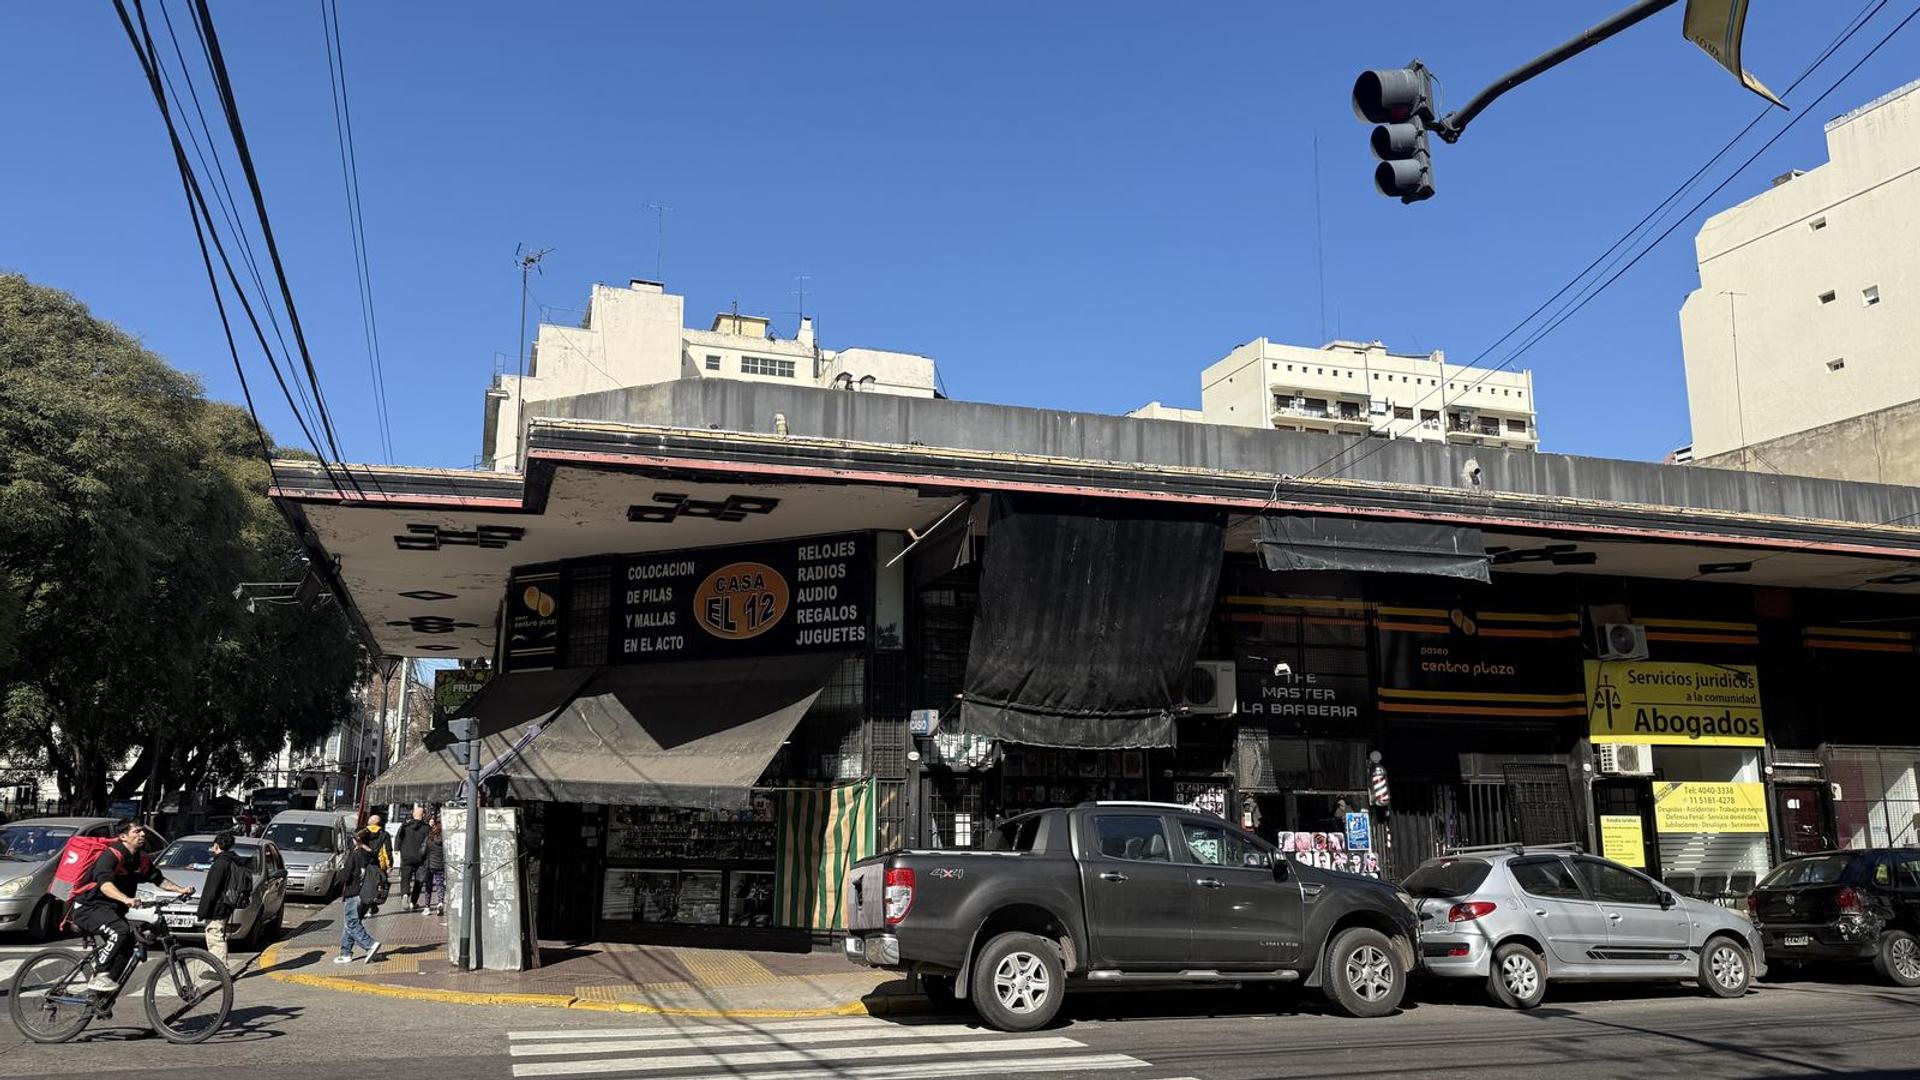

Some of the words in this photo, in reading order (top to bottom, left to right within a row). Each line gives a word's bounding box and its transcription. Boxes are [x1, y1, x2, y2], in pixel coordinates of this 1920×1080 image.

[798, 541, 855, 561] RELOJES
[628, 562, 695, 580] COLOCACION
[798, 563, 846, 582] RADIOS
[715, 572, 766, 593] CASA
[626, 589, 642, 604] DE
[643, 587, 673, 603] PILAS
[797, 585, 837, 603] AUDIO
[625, 614, 634, 629] Y
[634, 611, 676, 628] MALLAS
[706, 596, 738, 633] EL
[745, 591, 776, 630] 12
[797, 604, 857, 624] REGALOS
[624, 638, 638, 653] EN
[640, 637, 653, 652] EL
[655, 635, 684, 651] ACTO
[795, 625, 866, 646] JUGUETES
[1422, 660, 1470, 673] centro
[1473, 661, 1515, 677] plaza
[1628, 669, 1692, 686] Servicios
[1262, 687, 1336, 701] MASTER
[1694, 691, 1703, 702] la
[1704, 693, 1757, 704] comunidad
[1241, 701, 1264, 715] LA
[1270, 703, 1358, 718] BARBERIA
[1634, 707, 1760, 740] Abogados
[1684, 786, 1696, 794] Tel:
